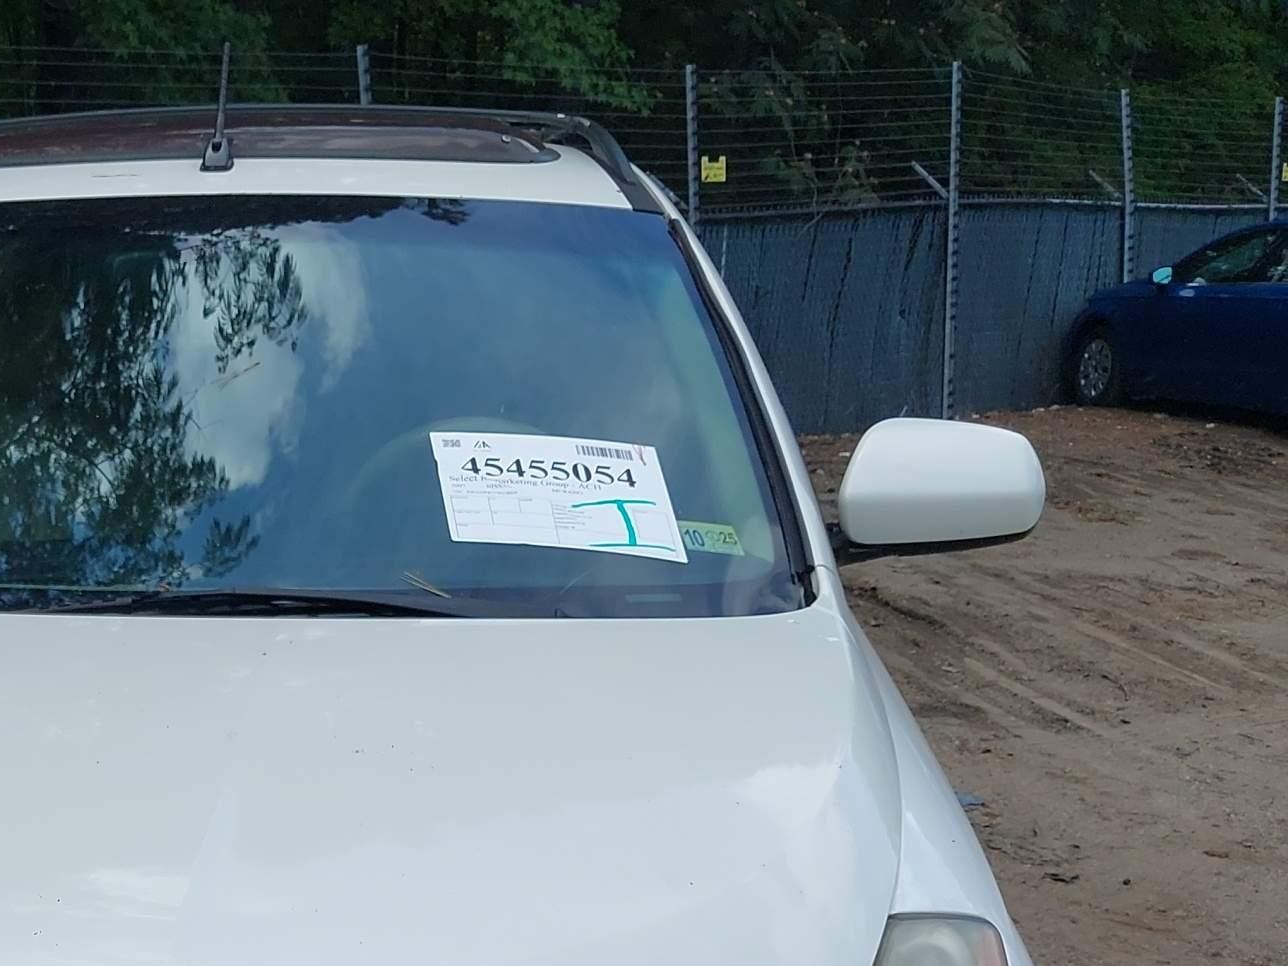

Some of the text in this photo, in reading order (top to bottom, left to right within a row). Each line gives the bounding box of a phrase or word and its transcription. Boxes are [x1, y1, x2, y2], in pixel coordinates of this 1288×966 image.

[461, 456, 637, 489] 45455054
[684, 529, 737, 546] 10 25
